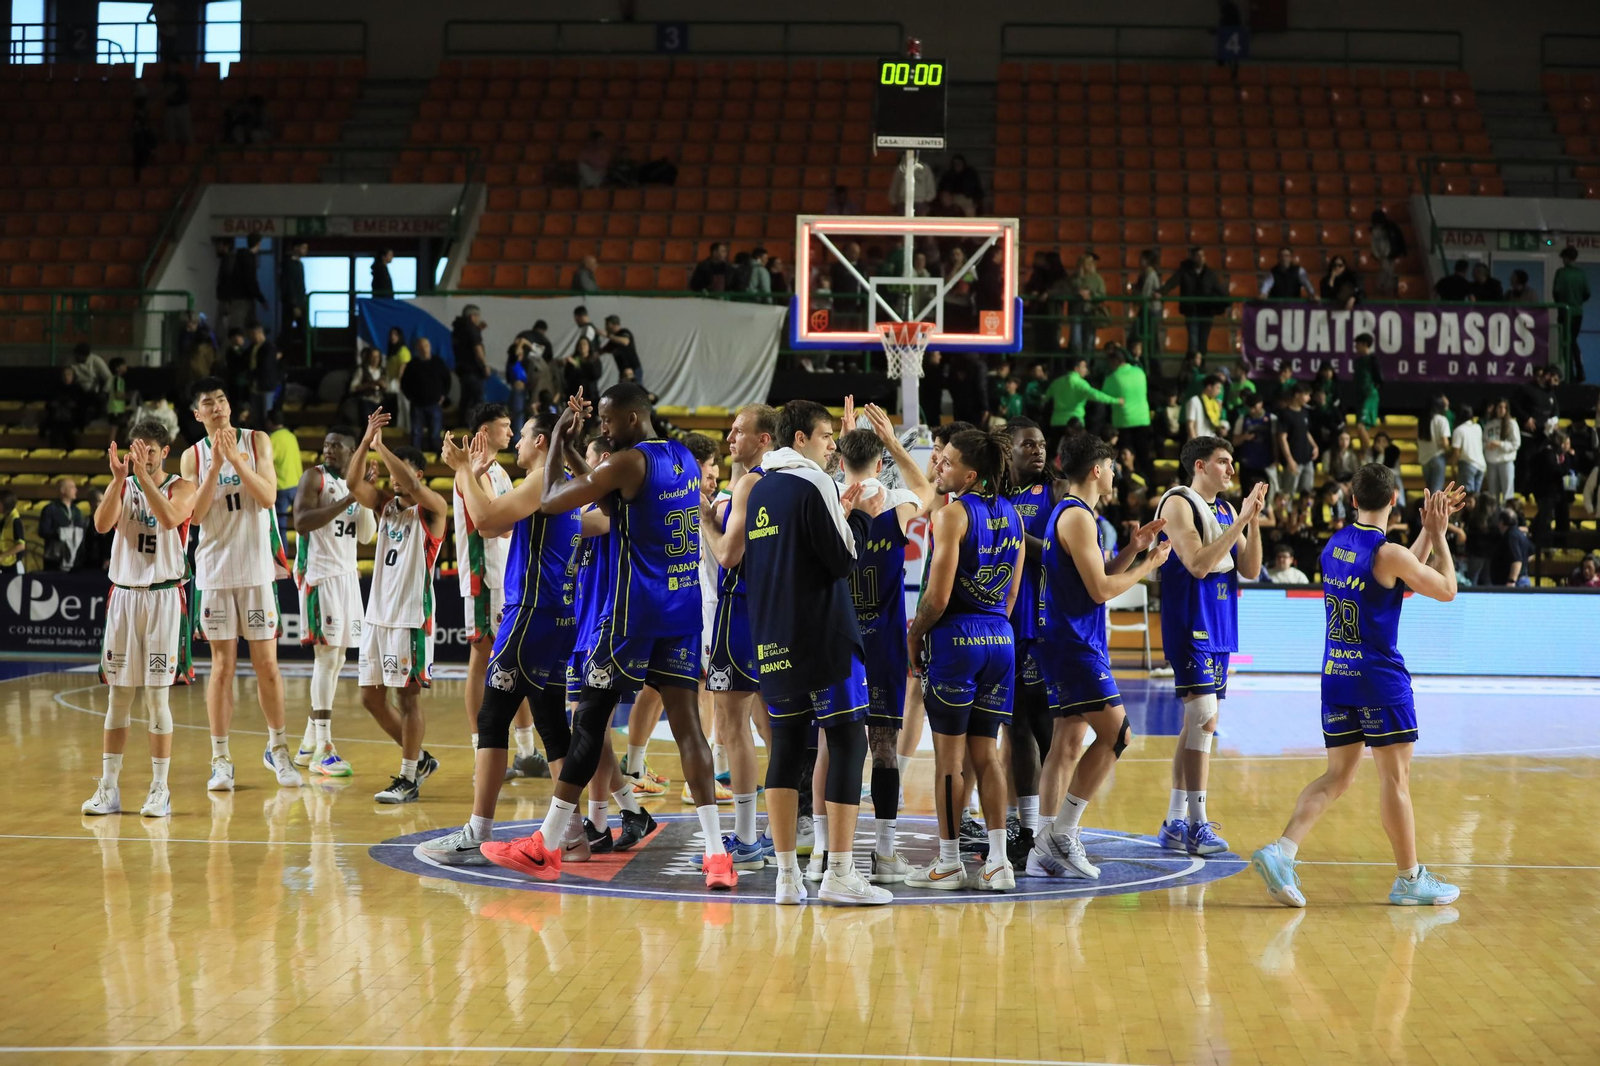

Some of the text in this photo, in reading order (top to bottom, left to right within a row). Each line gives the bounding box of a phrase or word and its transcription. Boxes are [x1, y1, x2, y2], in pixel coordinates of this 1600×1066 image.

[665, 26, 680, 50] 3
[1224, 31, 1241, 55] 4
[880, 62, 943, 86] 00:00
[1442, 231, 1486, 245] AIDA
[1255, 307, 1536, 357] CUATRO PASOS
[1254, 356, 1535, 377] ESCUEL DE DANZA
[225, 492, 242, 512] 11
[334, 519, 356, 538] 34
[664, 505, 700, 558] 35
[137, 533, 157, 554] 15
[385, 548, 398, 567] 0
[1216, 582, 1228, 600] 12
[1325, 593, 1362, 644] 28
[27, 637, 55, 646] Avenida
[55, 637, 87, 648] Santiago
[952, 636, 1012, 647] TRANSITERIA
